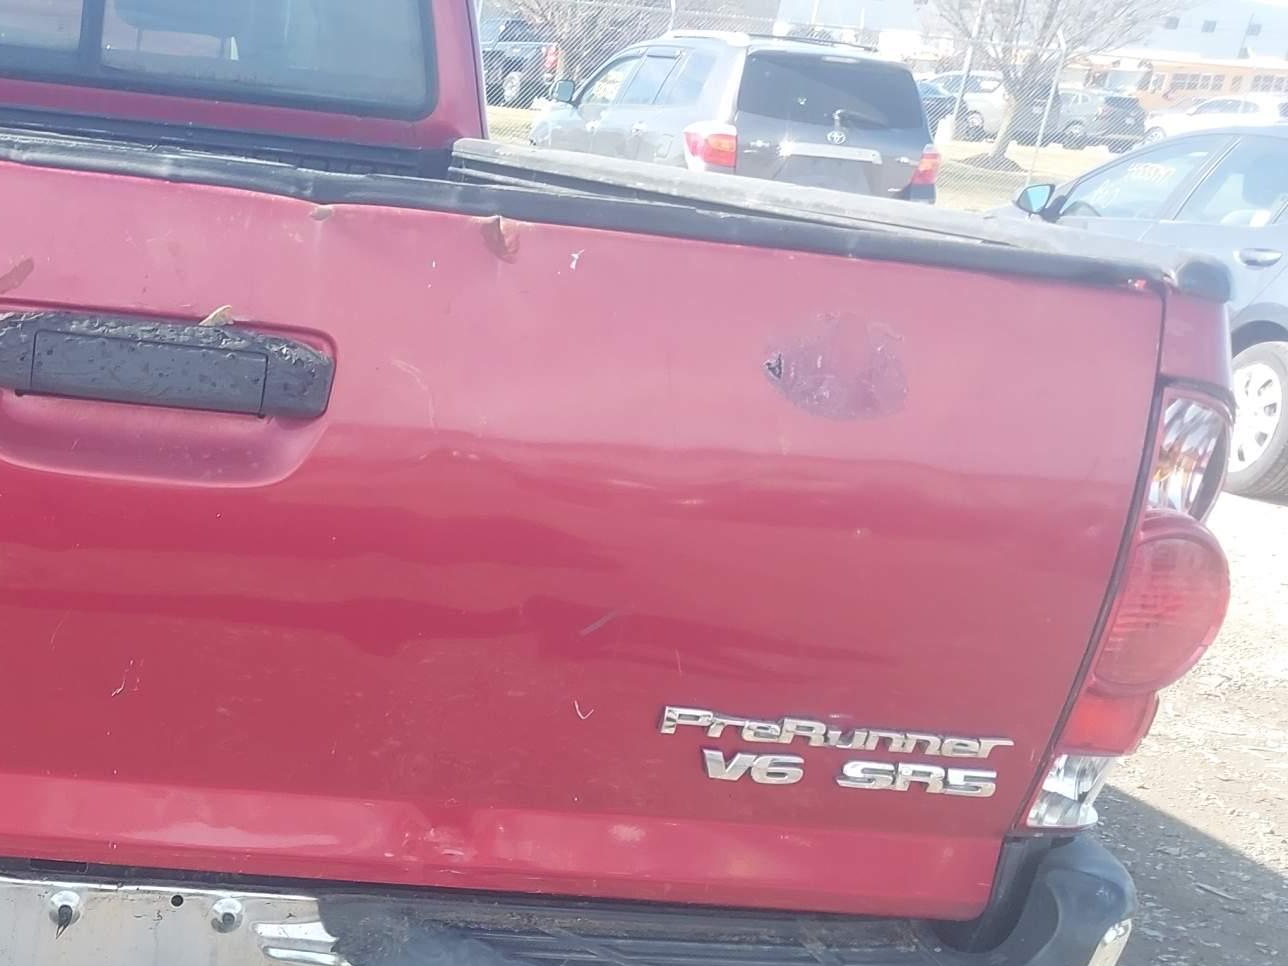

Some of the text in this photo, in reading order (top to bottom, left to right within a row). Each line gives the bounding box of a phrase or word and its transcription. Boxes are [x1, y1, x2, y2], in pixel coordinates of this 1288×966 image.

[660, 705, 1015, 758] PreRunner
[703, 748, 998, 798] V6 SR5
